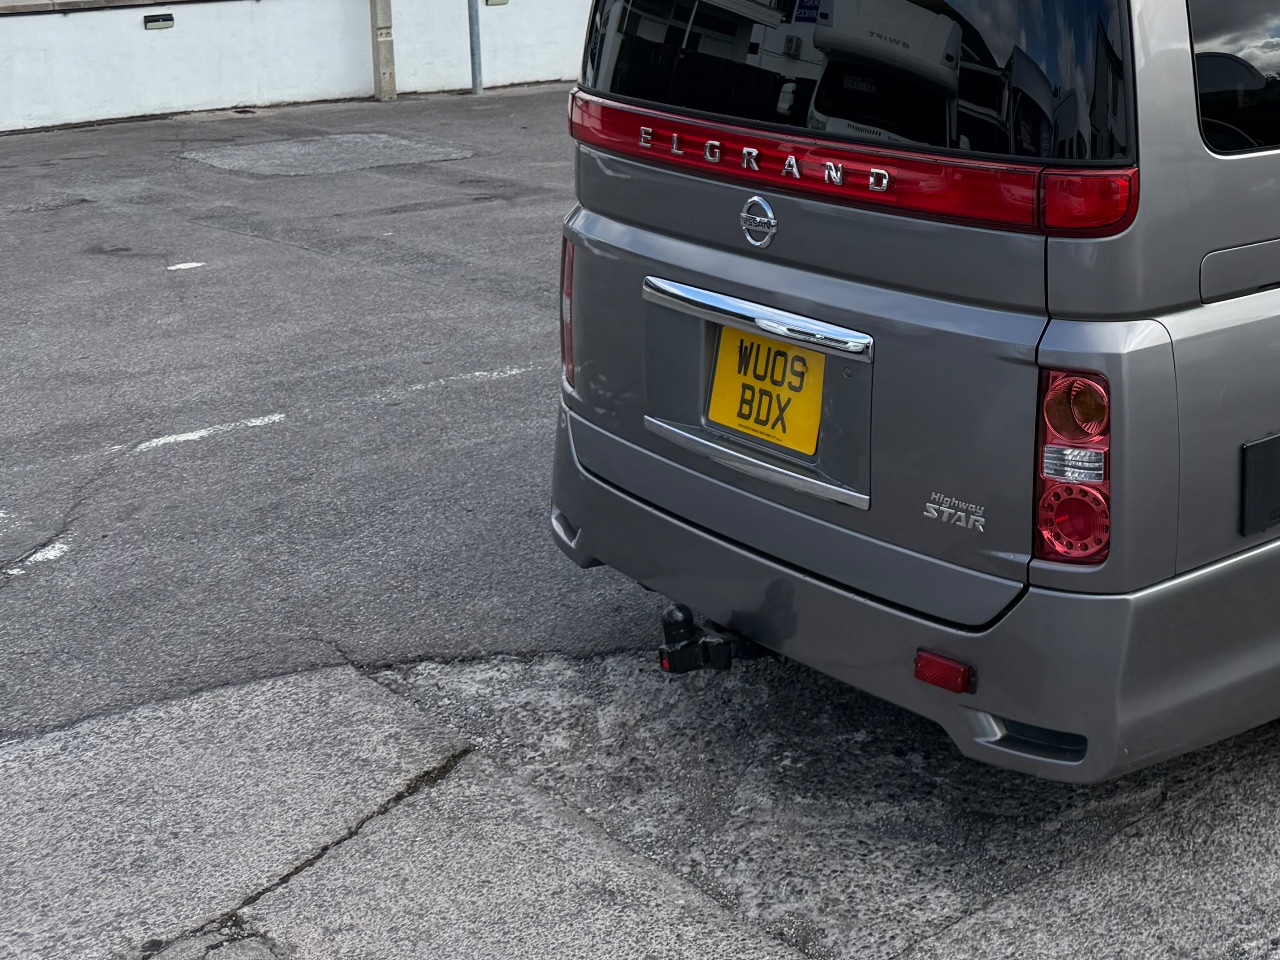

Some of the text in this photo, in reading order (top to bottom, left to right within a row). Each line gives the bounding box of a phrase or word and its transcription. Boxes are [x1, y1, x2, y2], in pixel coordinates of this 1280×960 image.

[639, 126, 889, 192] ELGRAND
[742, 215, 772, 230] NISSAN
[737, 339, 807, 393] WU09
[736, 382, 792, 434] BDX
[923, 502, 986, 532] STAR
[930, 491, 985, 516] Highway
